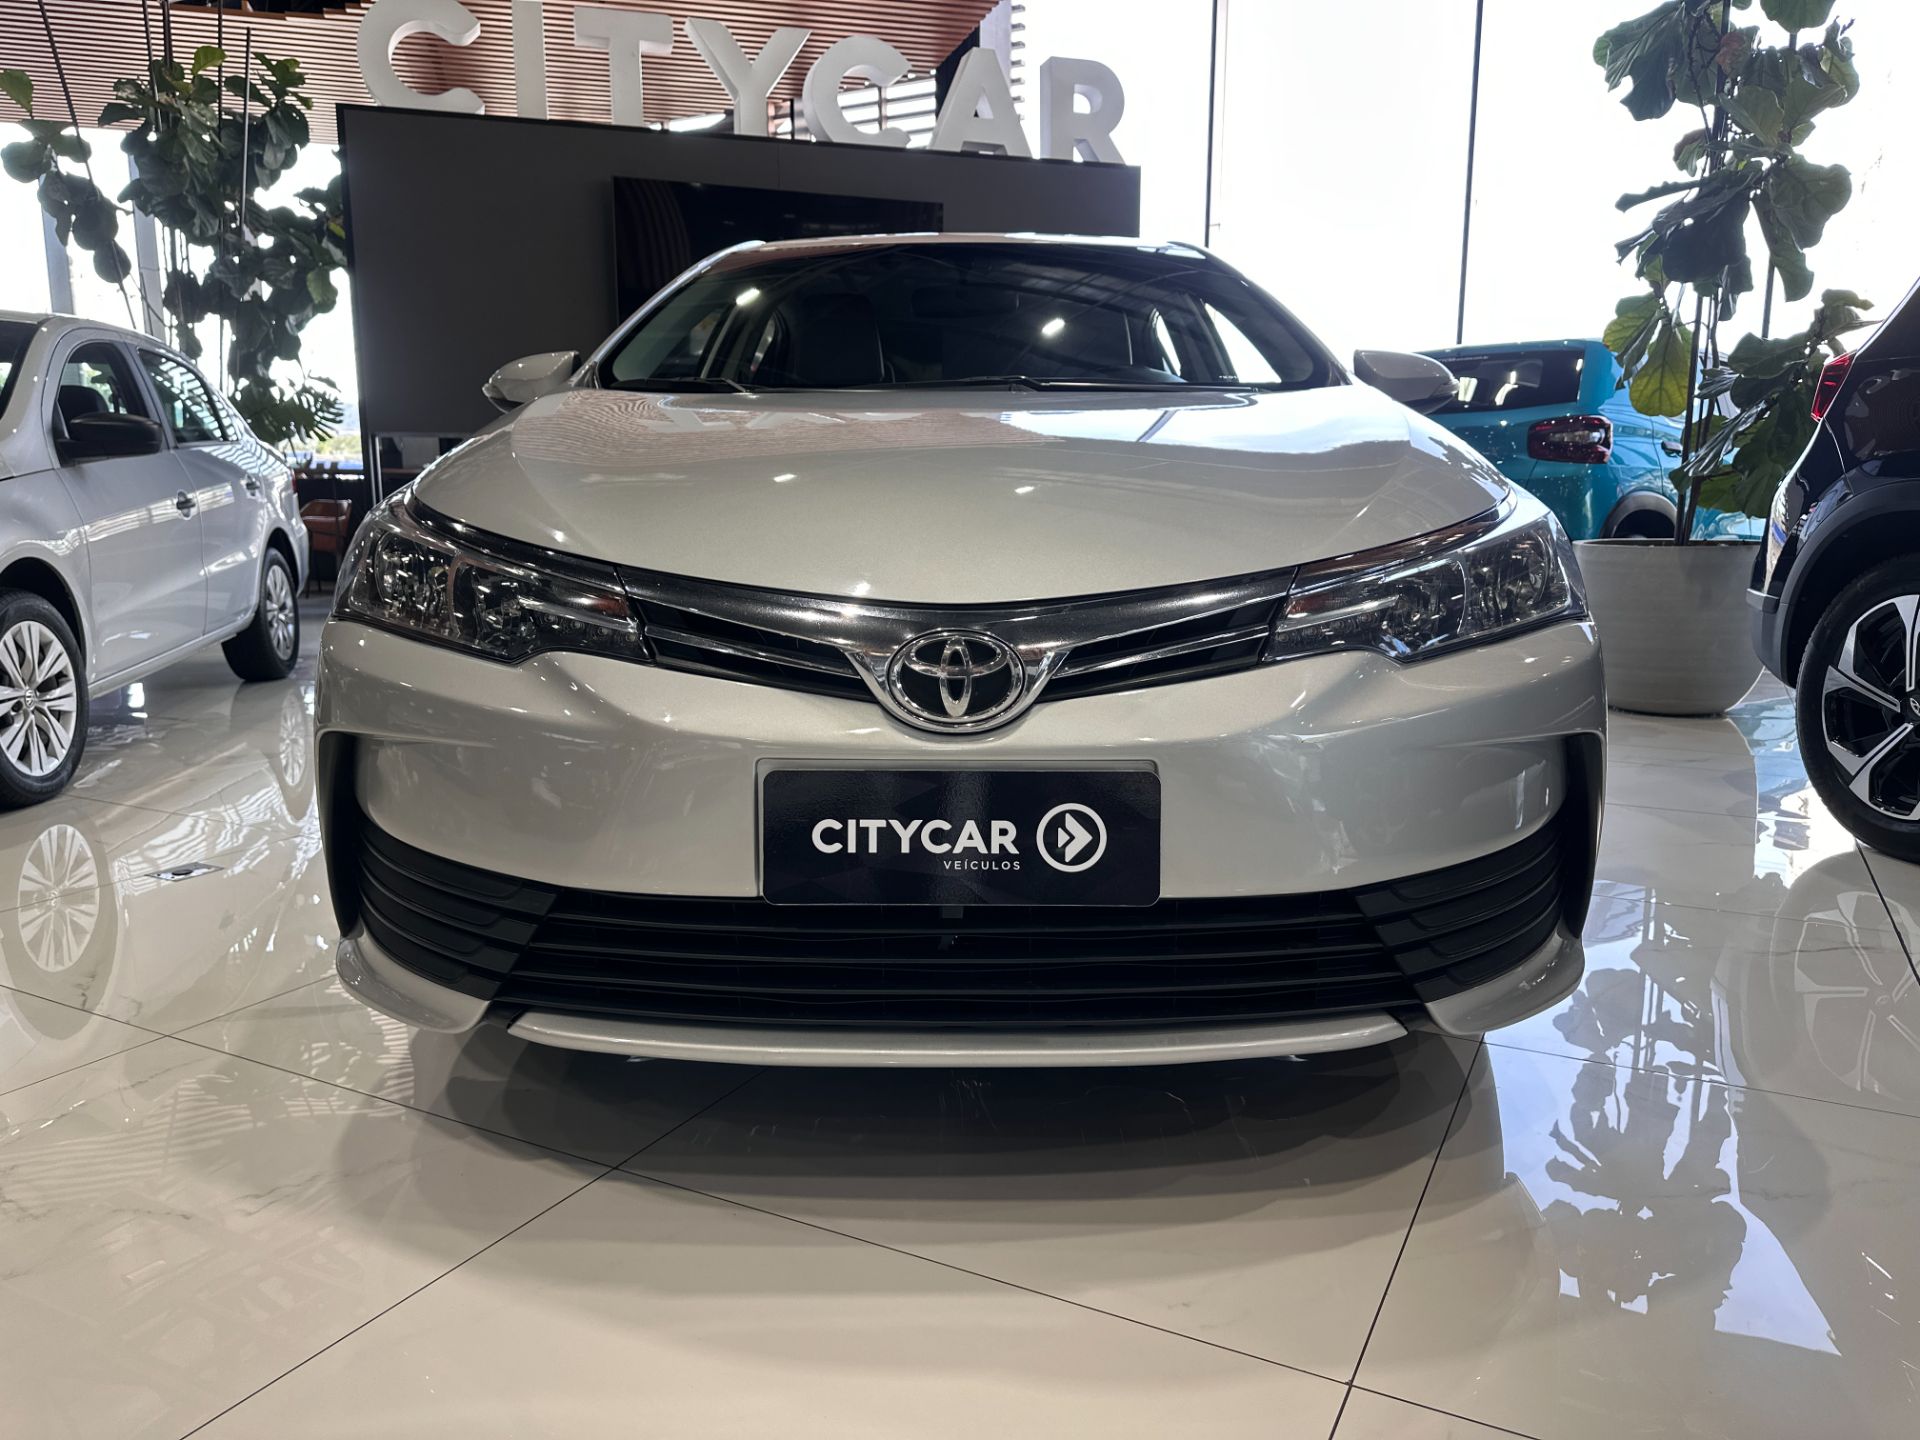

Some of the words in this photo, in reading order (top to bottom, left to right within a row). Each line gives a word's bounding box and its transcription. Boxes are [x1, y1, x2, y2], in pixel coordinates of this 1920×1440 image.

[357, 0, 1126, 165] CITYCAR
[811, 818, 1020, 854] CITYCAR
[943, 858, 1021, 871] VEÍCULOS
